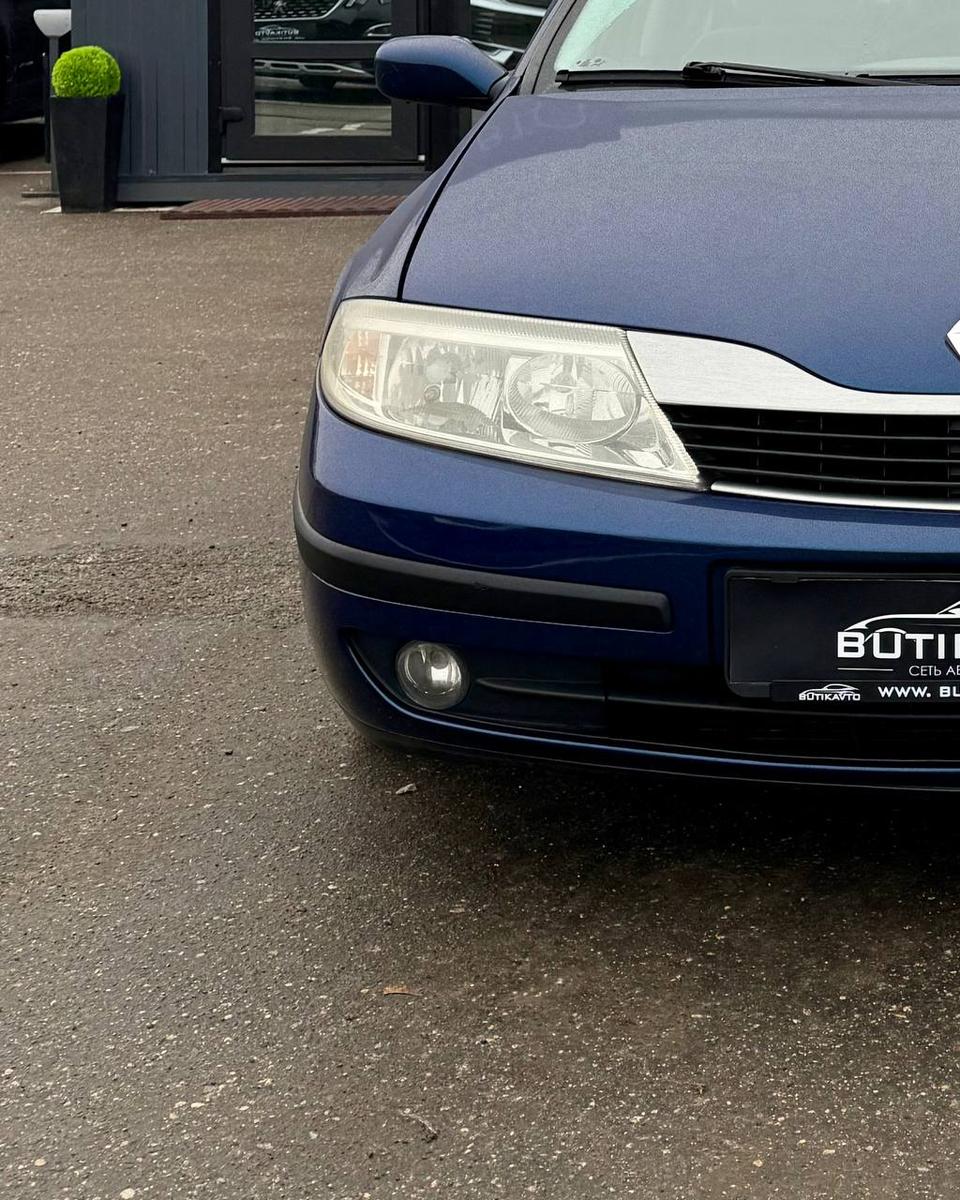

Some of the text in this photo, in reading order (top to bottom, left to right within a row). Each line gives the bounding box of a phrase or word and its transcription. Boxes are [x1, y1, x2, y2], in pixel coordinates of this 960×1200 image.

[908, 664, 942, 677] СЕТЬ
[799, 692, 861, 701] BUTIKAVTO
[878, 686, 931, 699] WWW.
